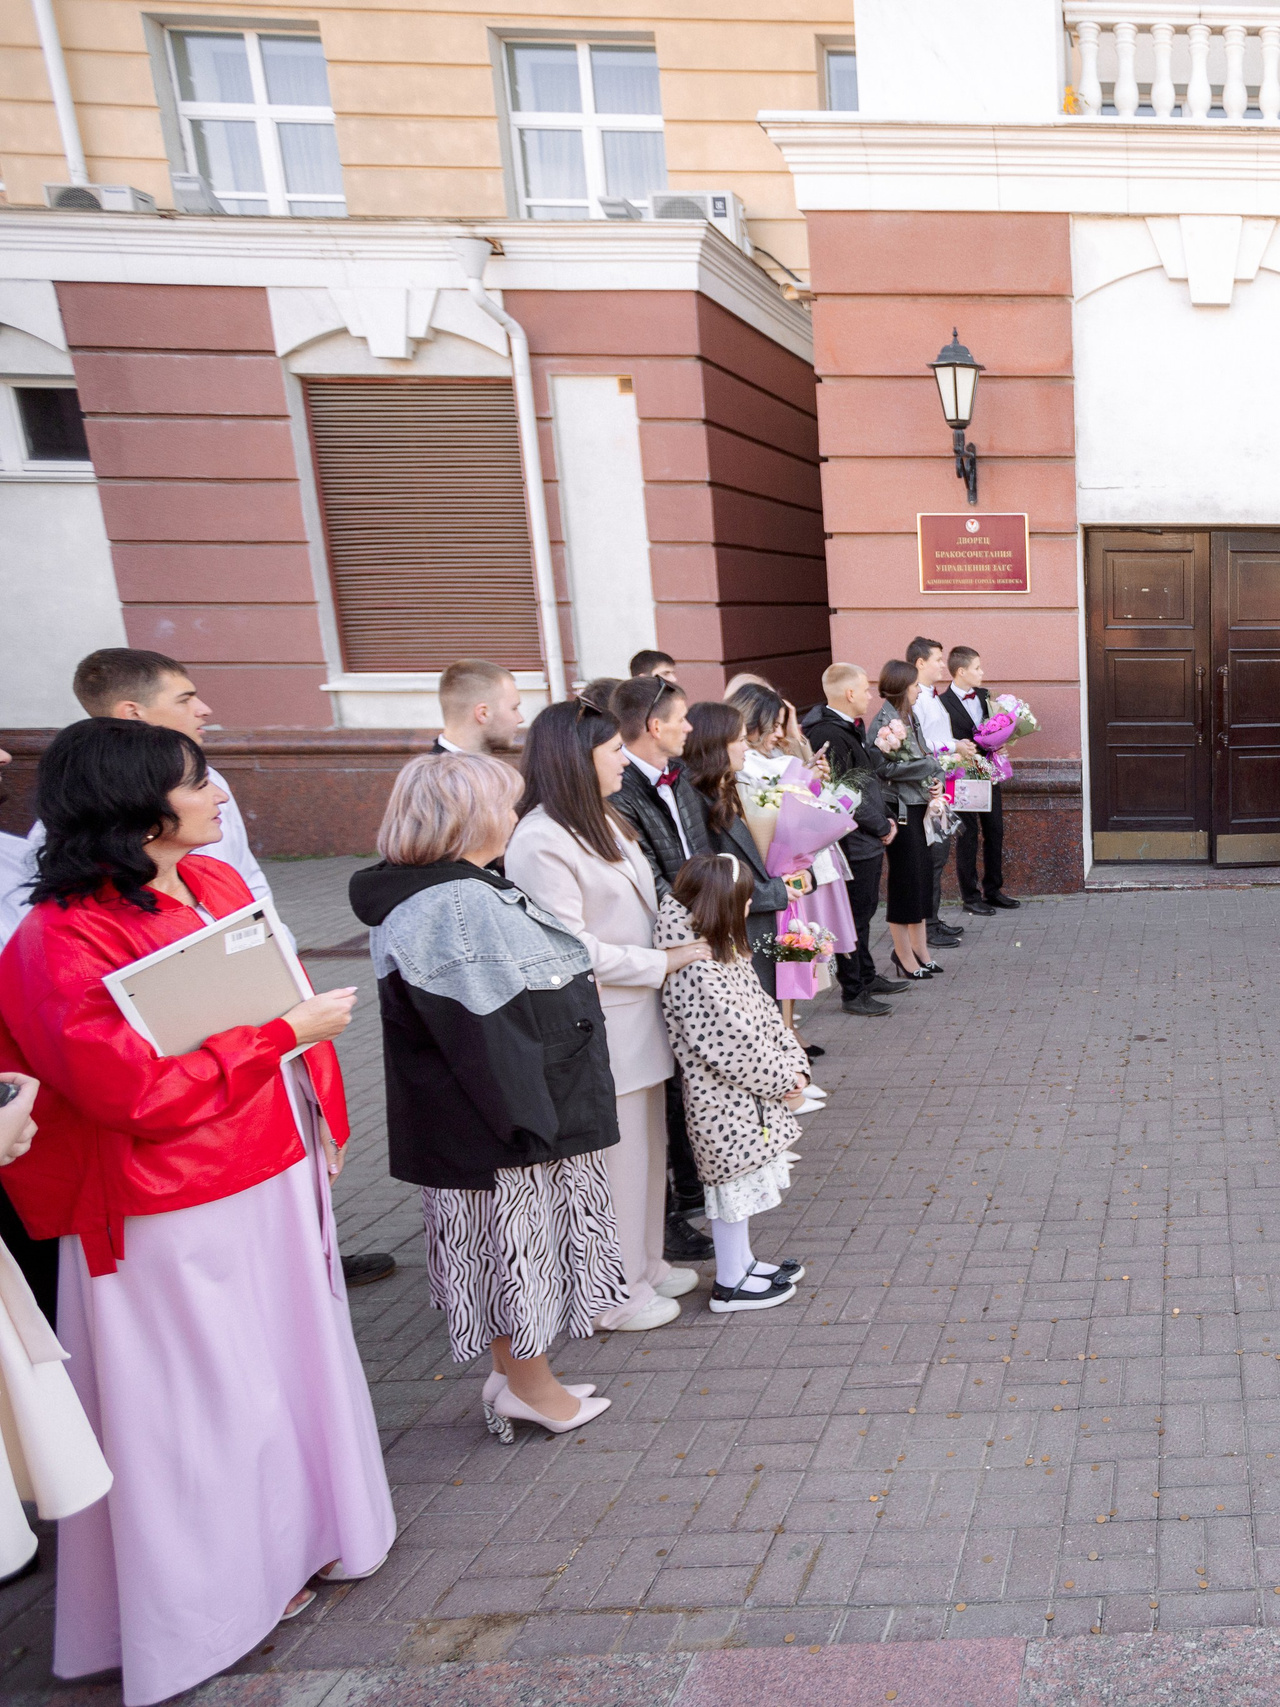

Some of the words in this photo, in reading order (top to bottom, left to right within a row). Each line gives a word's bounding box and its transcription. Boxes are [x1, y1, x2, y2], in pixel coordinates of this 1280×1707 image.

[956, 537, 991, 545] ДВОРЕЦ
[935, 550, 1012, 559] БРАКОСОЧЕТАНИЯ
[935, 564, 990, 572] УПРАВЛЕНИЯ
[992, 564, 1013, 572] ЗАГС
